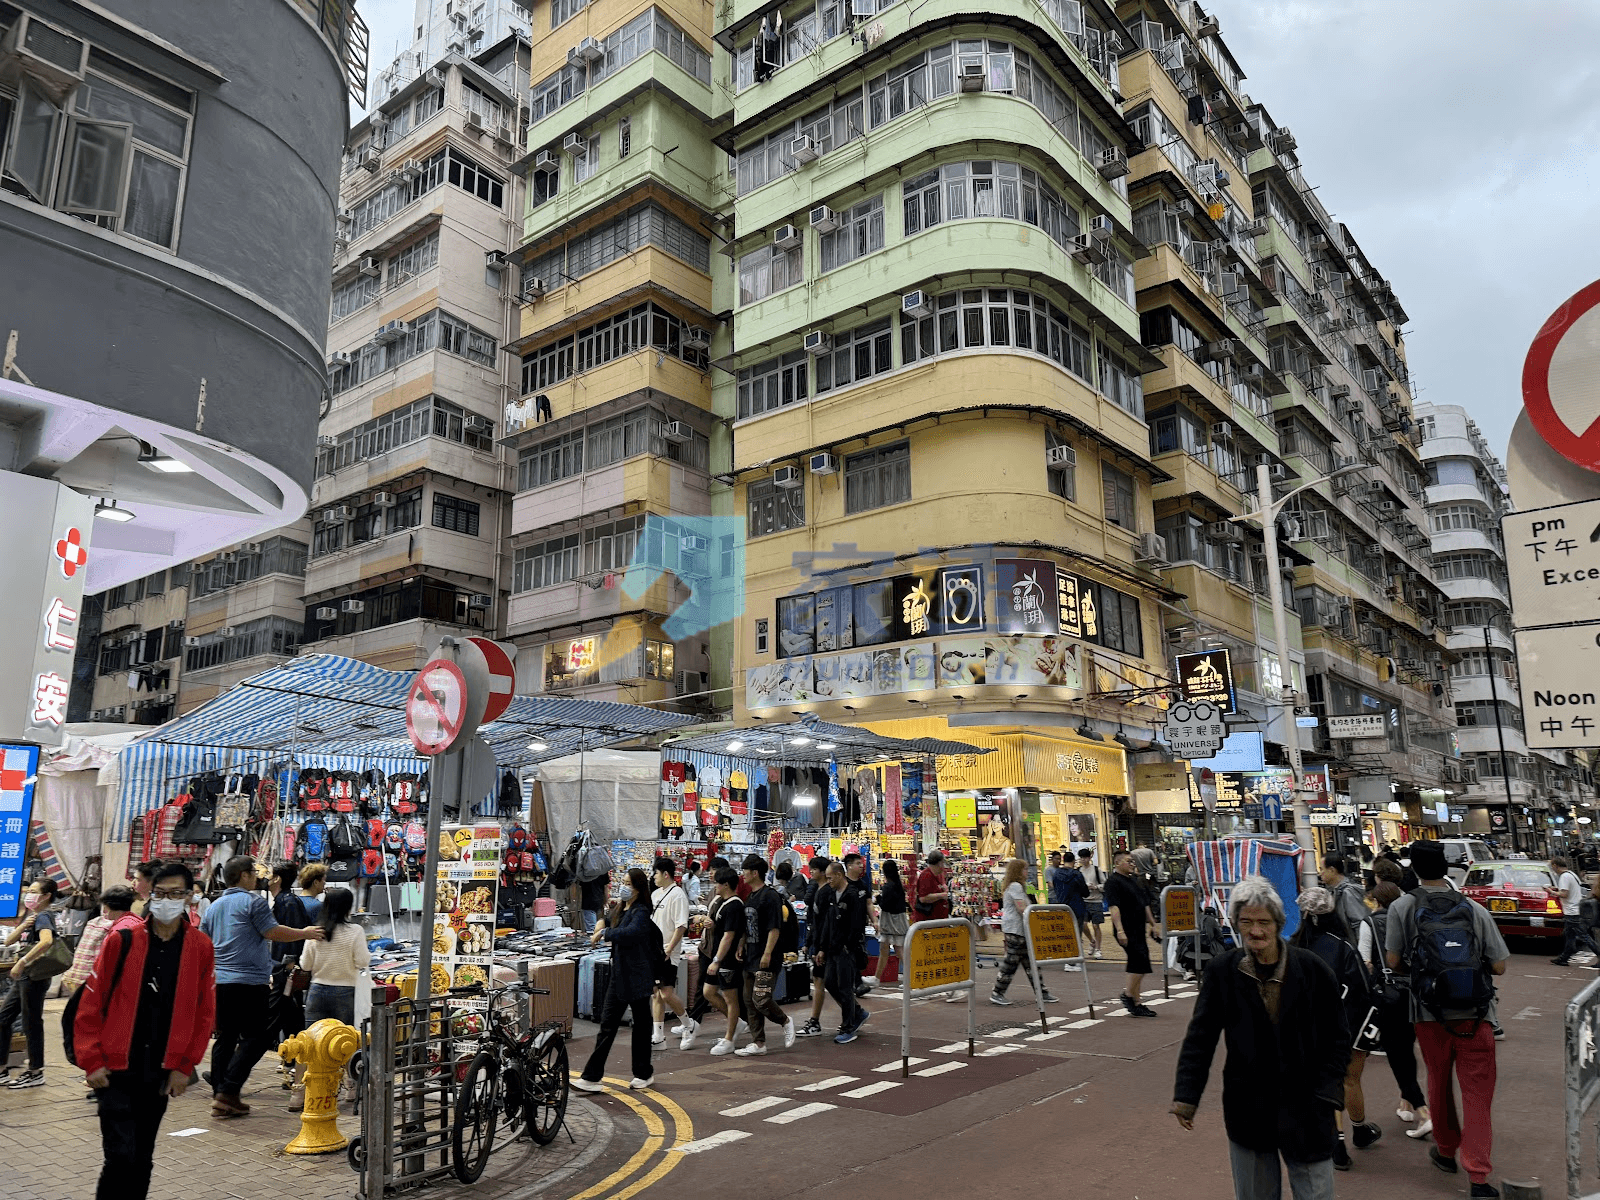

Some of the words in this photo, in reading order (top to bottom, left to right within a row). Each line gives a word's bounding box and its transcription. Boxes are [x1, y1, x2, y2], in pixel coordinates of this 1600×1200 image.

[1531, 518, 1565, 538] pm
[1524, 538, 1579, 562] 下午
[1543, 567, 1600, 586] Exce
[33, 597, 78, 725] 仁安
[1533, 690, 1595, 708] Noon
[1540, 715, 1595, 738] 中午
[1174, 740, 1218, 749] UNIVERSE
[307, 1095, 333, 1111] 275
